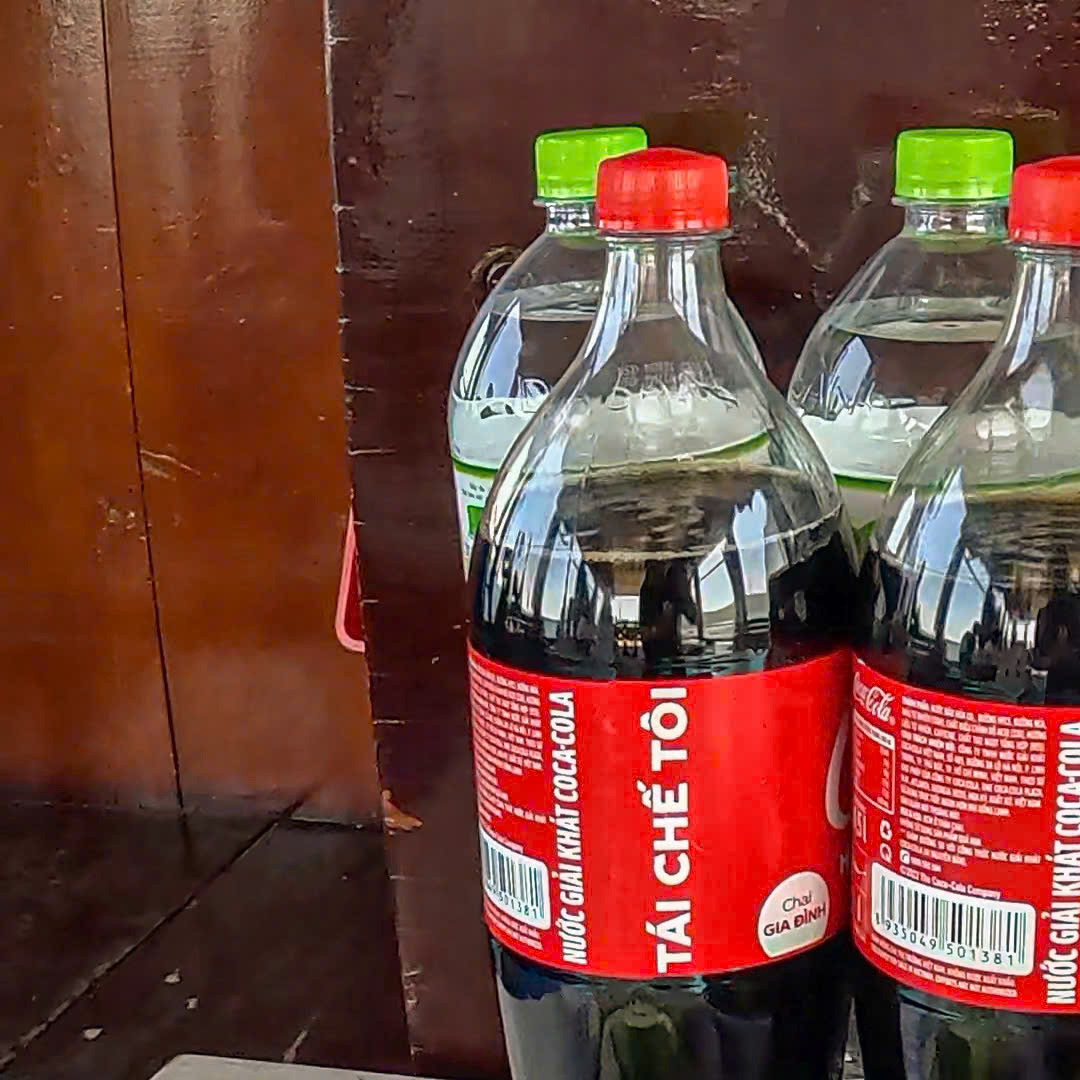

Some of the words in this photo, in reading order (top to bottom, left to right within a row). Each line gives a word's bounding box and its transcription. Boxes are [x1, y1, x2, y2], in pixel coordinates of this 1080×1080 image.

[548, 690, 581, 803] COCA-COLA
[639, 686, 689, 772] TÔI
[549, 804, 583, 856] KHÁT
[636, 779, 692, 887] CHẾ
[551, 855, 586, 907] GIẢI
[782, 889, 812, 912] Chai
[556, 909, 589, 965] NƯỚC
[645, 899, 692, 974] TÁI
[763, 919, 791, 937] GIA
[793, 901, 827, 929] ĐÌNH
[1045, 947, 1079, 1005] NƯỚC
